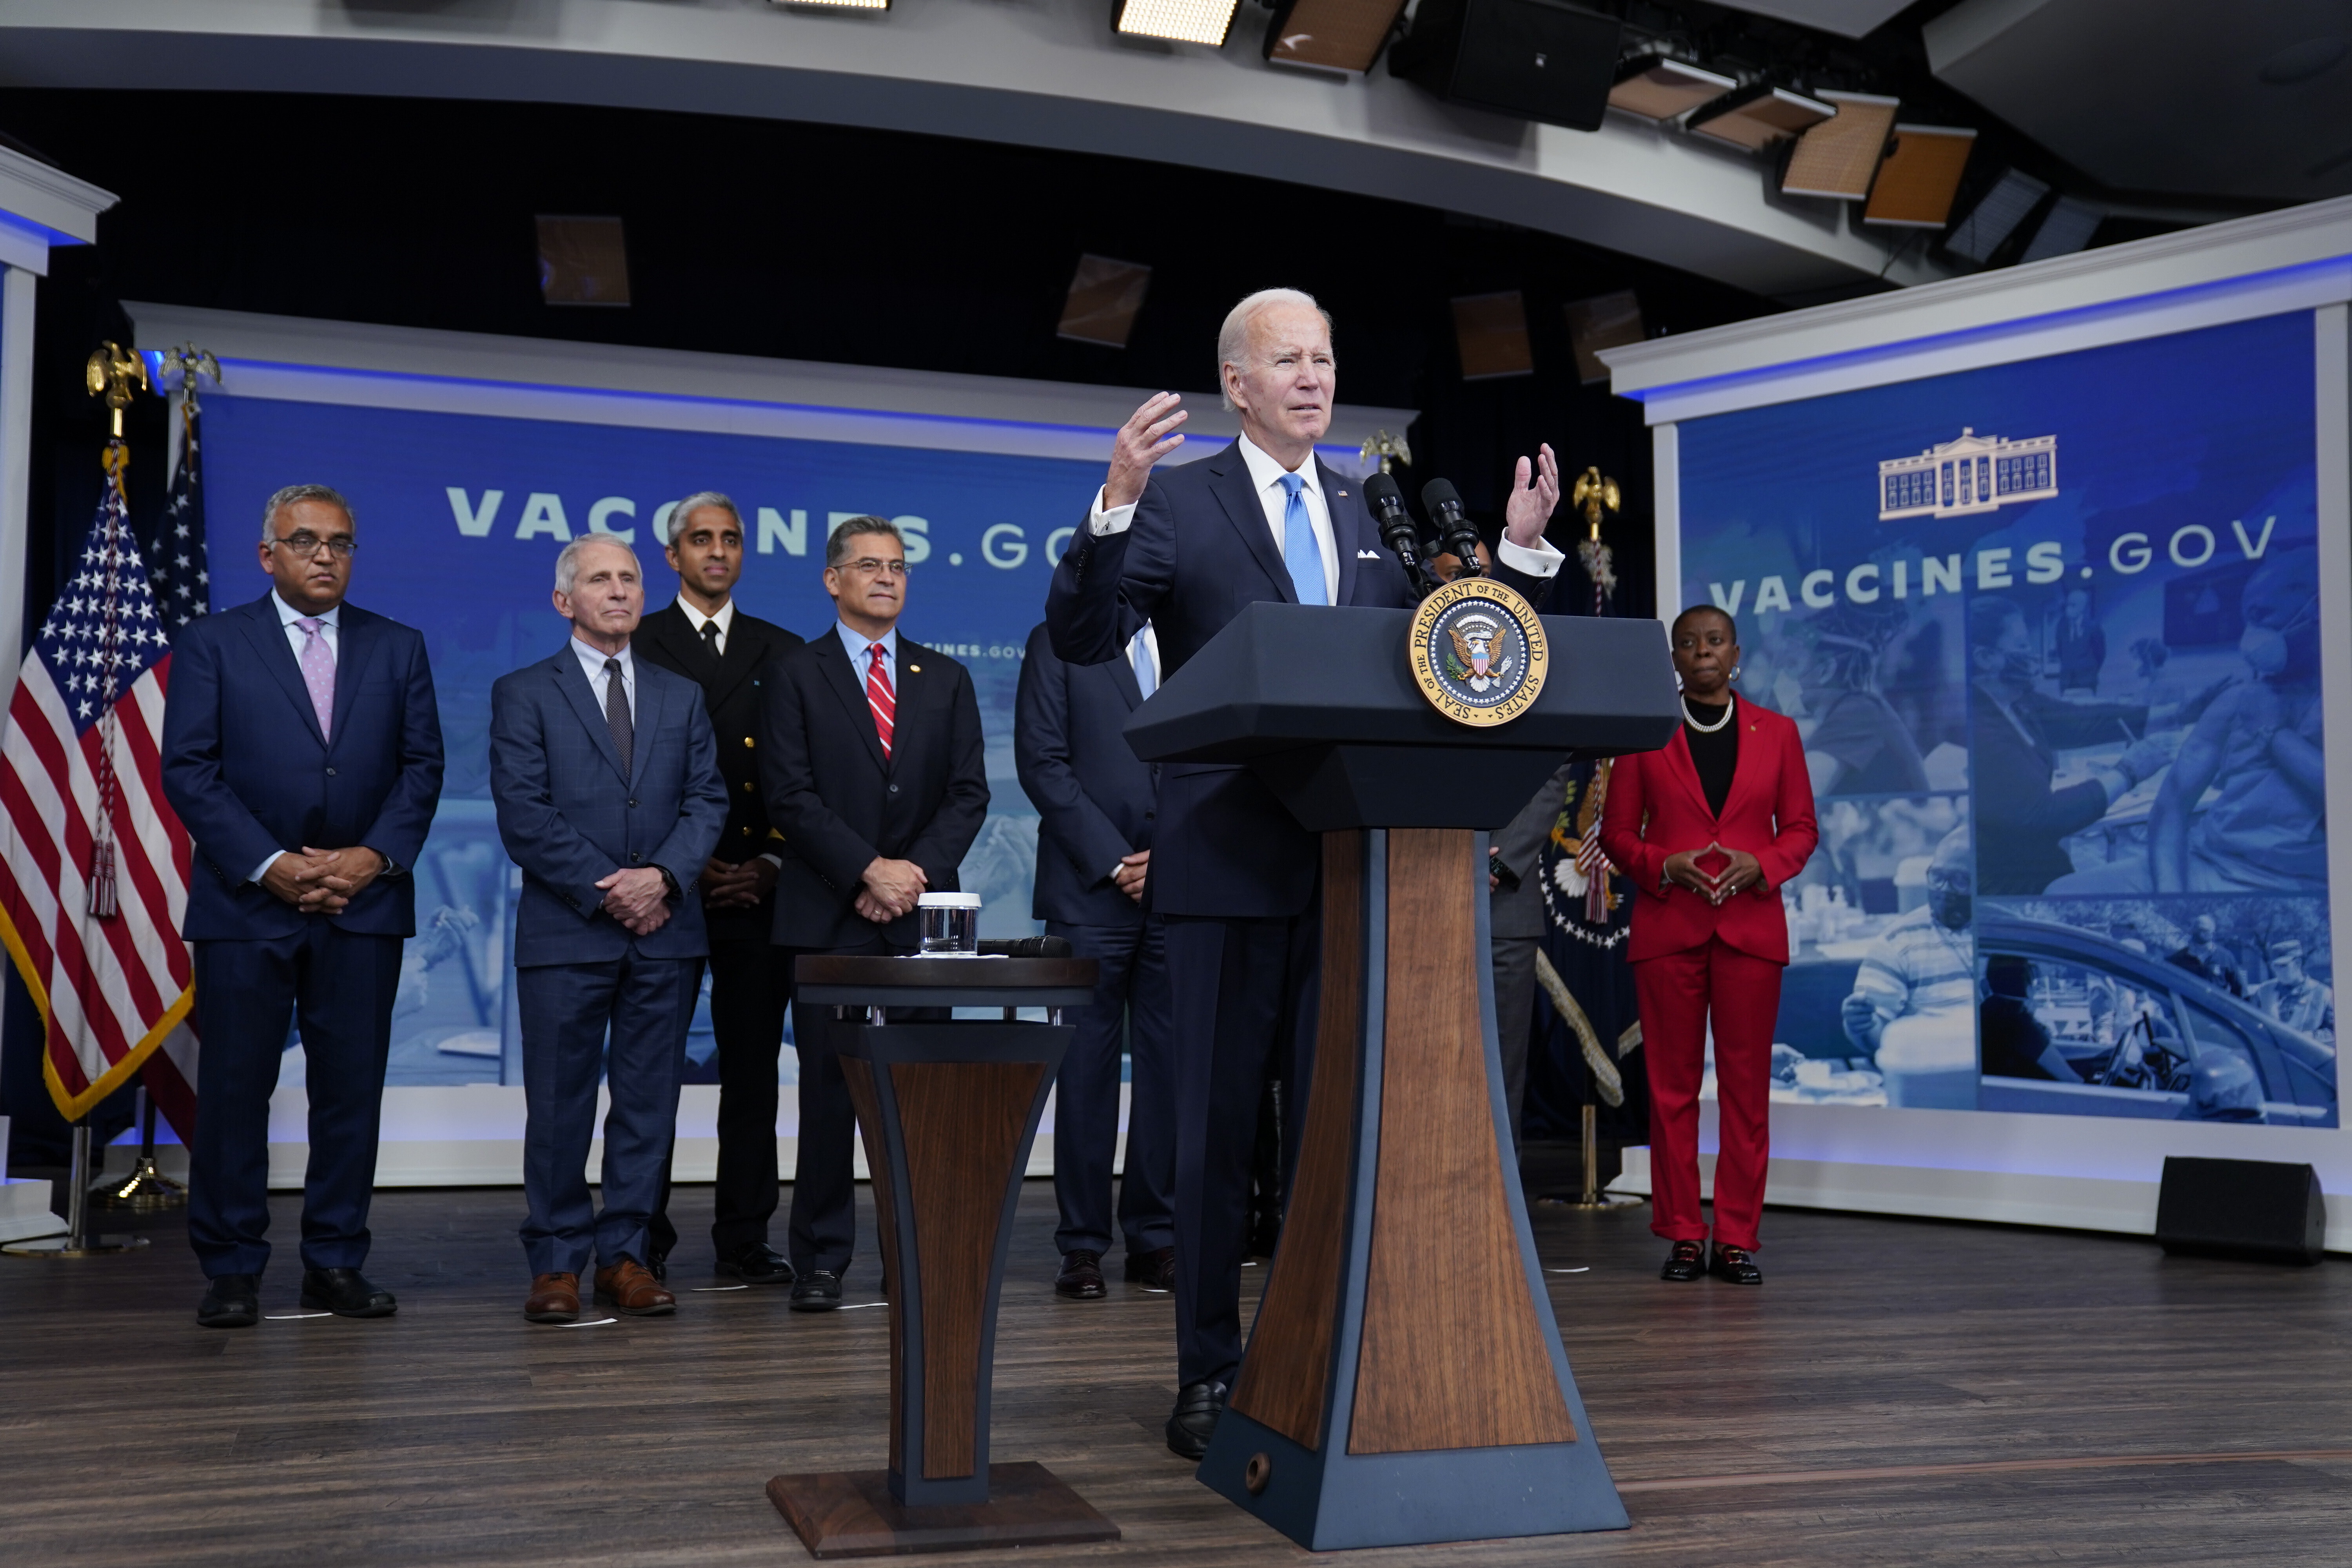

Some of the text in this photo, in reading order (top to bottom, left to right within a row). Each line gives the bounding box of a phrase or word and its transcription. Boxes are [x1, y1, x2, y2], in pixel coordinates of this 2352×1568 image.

[446, 487, 1077, 569] VACNS.G
[1710, 515, 2276, 617] VACCINES.GOV
[915, 642, 1025, 660] INES.GOV
[1415, 583, 1543, 719] SEAL OF THE PRESIDENT OF THE UNITED STATES
